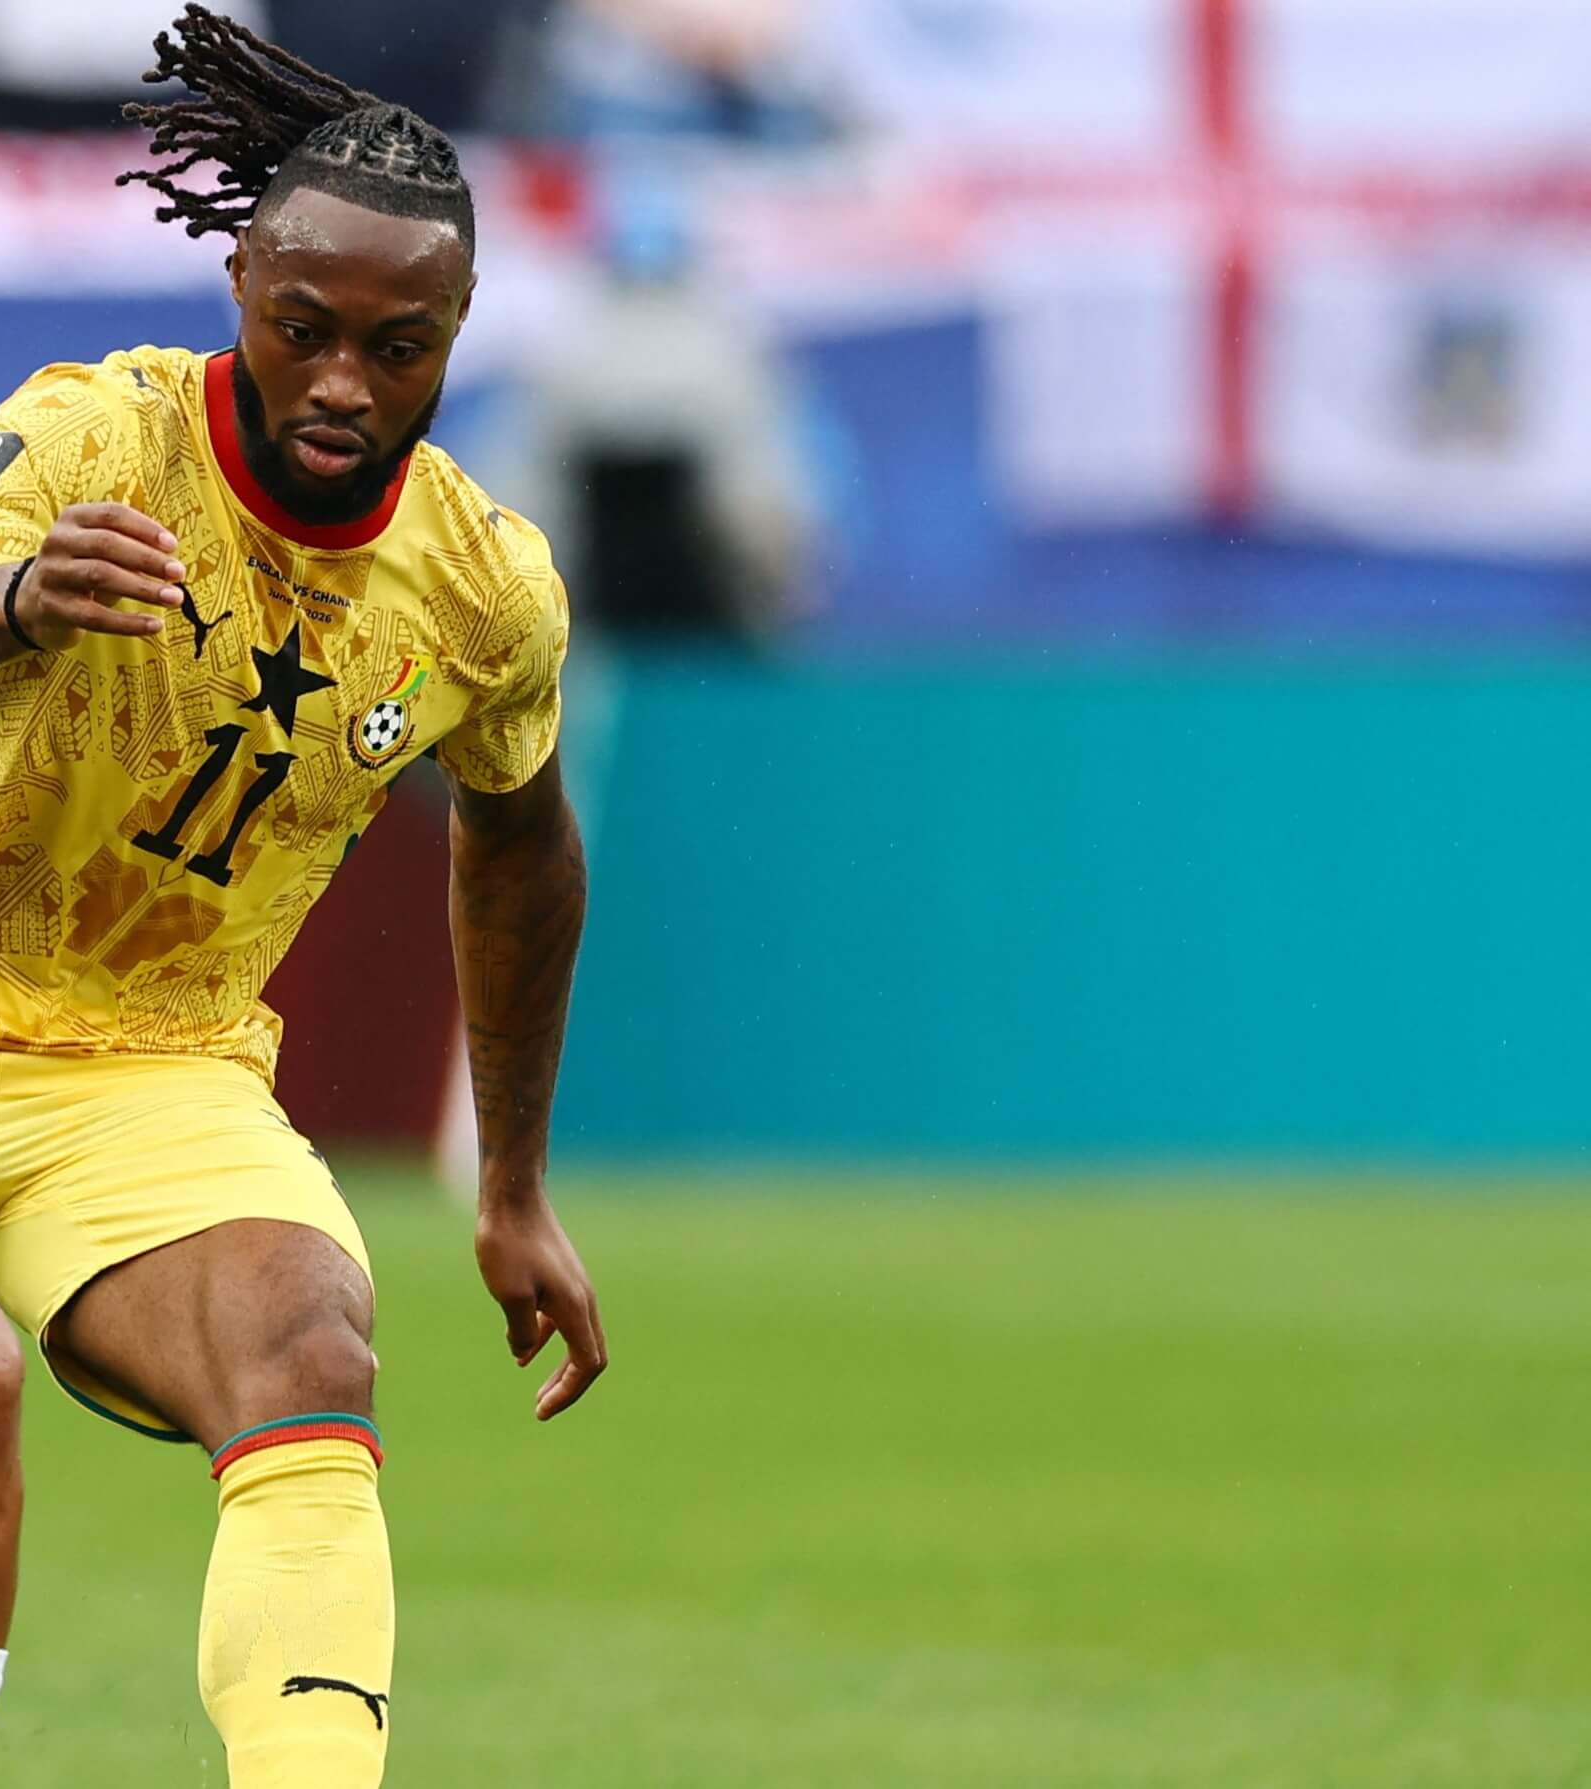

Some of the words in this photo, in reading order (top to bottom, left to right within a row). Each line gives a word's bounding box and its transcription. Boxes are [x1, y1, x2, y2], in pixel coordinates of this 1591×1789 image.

[292, 582, 310, 598] VS
[311, 589, 352, 609] GHANA
[130, 722, 299, 887] 11
